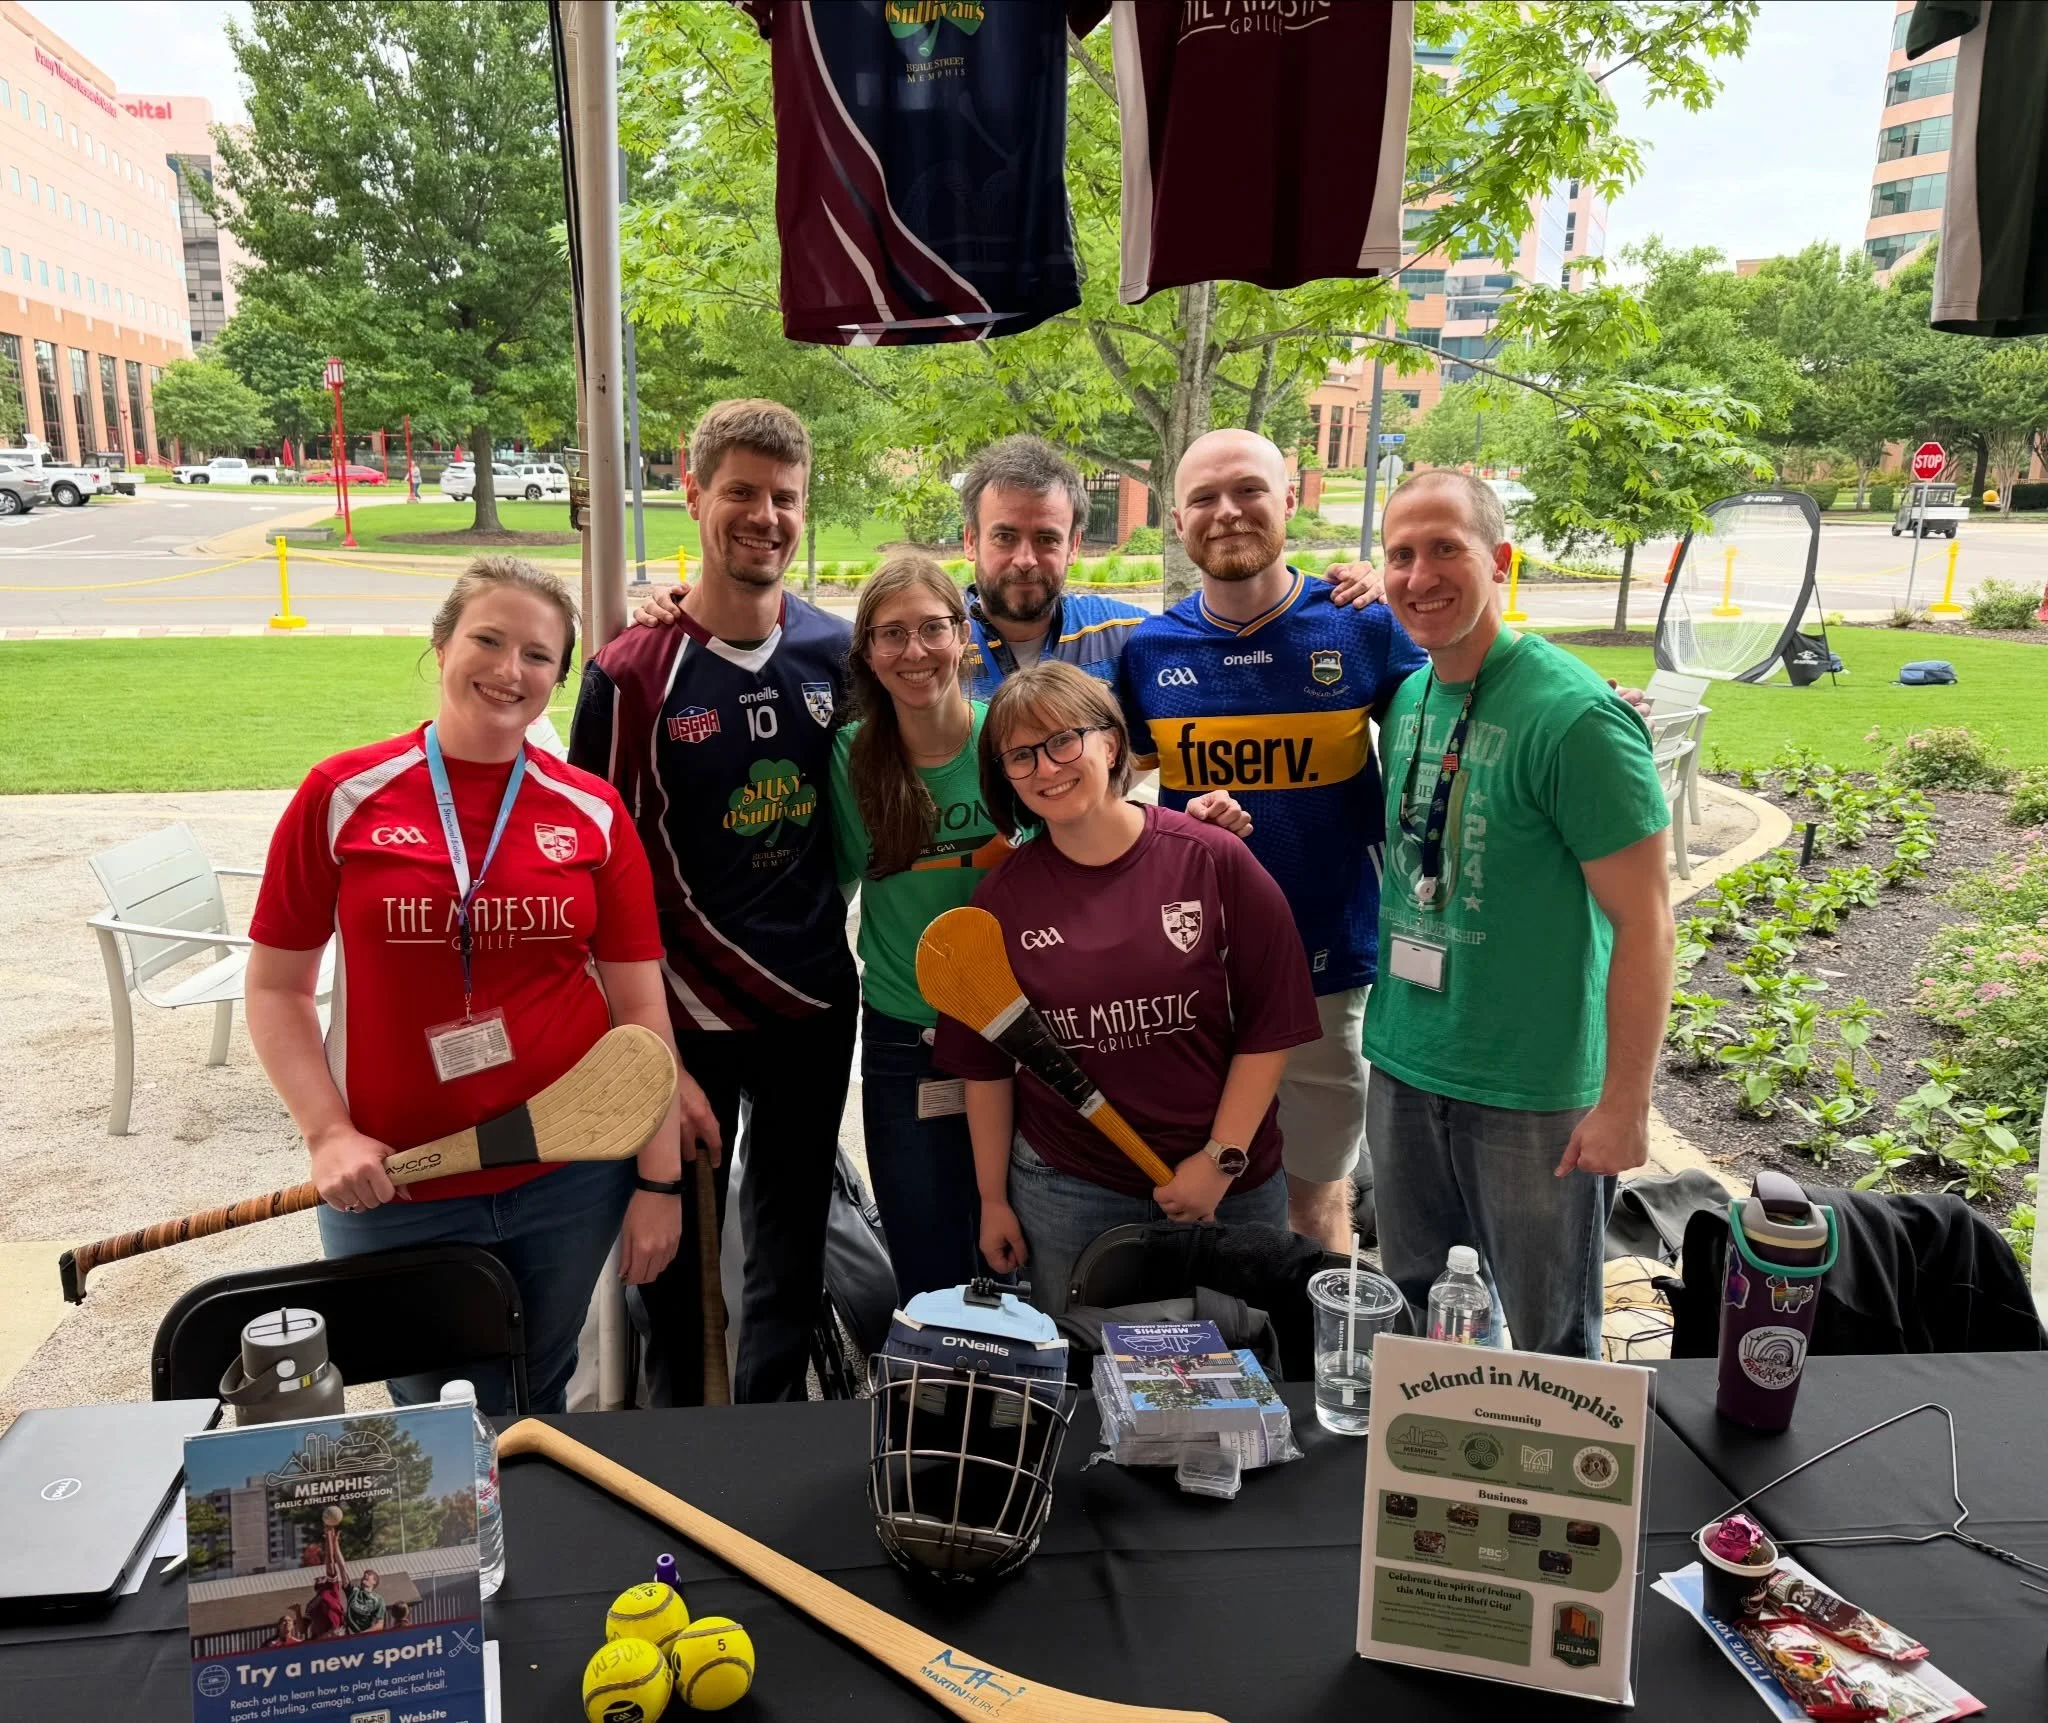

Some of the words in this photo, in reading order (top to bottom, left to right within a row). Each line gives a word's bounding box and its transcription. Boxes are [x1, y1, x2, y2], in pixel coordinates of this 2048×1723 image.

[906, 62, 933, 72] BEALE
[934, 56, 965, 68] STREET
[906, 68, 966, 84] MEMPHIS
[1915, 454, 1942, 469] STOP
[1224, 650, 1274, 666] o'neills
[738, 686, 780, 704] o'neills
[667, 709, 721, 741] USGAA
[746, 705, 778, 742] 10
[1177, 722, 1319, 786] fiserv.
[742, 772, 806, 806] SILKY
[382, 897, 432, 933] THE
[445, 896, 575, 933] MAJESTIC
[1041, 1007, 1083, 1040] THE
[1090, 989, 1200, 1038] MAJESTIC
[1098, 1032, 1151, 1053] GRILLE
[942, 1336, 1009, 1357] O'Neills
[1399, 1365, 1484, 1401] Ireland
[1490, 1366, 1513, 1386] in
[1517, 1368, 1625, 1430] Memphis
[1474, 1407, 1542, 1428] Community
[294, 1475, 373, 1498] MEMPHIS
[1478, 1489, 1529, 1506] Business
[274, 1500, 302, 1510] GAELIC
[303, 1494, 339, 1506] ATHLETIC
[340, 1487, 393, 1501] ASSOCIATION
[1478, 1546, 1503, 1558] PBC
[1388, 1571, 1433, 1585] Celebrate
[1434, 1577, 1448, 1588] the
[1449, 1580, 1475, 1594] spirit
[1476, 1585, 1488, 1595] of
[1488, 1586, 1522, 1601] Ireland
[1396, 1584, 1414, 1595] this
[1415, 1587, 1436, 1601] May
[1437, 1591, 1447, 1601] in
[1448, 1592, 1463, 1604] the
[1464, 1595, 1488, 1608] Bluff
[1489, 1599, 1512, 1612] City!
[717, 1638, 726, 1651] 5
[1556, 1642, 1596, 1658] IRELAND
[236, 1665, 277, 1688] Try
[285, 1662, 300, 1677] a
[310, 1652, 365, 1674] new
[372, 1635, 444, 1668] sport!
[1730, 1641, 1764, 1672] LOVE
[230, 1697, 260, 1710] Reach
[262, 1694, 277, 1706] out
[279, 1692, 289, 1702] to
[291, 1686, 315, 1700] learn
[317, 1682, 339, 1696] how
[340, 1682, 350, 1692] to
[352, 1678, 373, 1694] play
[374, 1675, 389, 1687] the
[391, 1670, 425, 1685] ancient
[426, 1667, 446, 1680] Irish
[230, 1707, 259, 1723] sports
[260, 1705, 271, 1717] of
[273, 1701, 309, 1716] hurling,
[311, 1694, 355, 1711] camogie,
[357, 1688, 376, 1702] and
[377, 1684, 409, 1700] Gaelic
[410, 1679, 448, 1695] football.
[398, 1709, 448, 1723] Website
